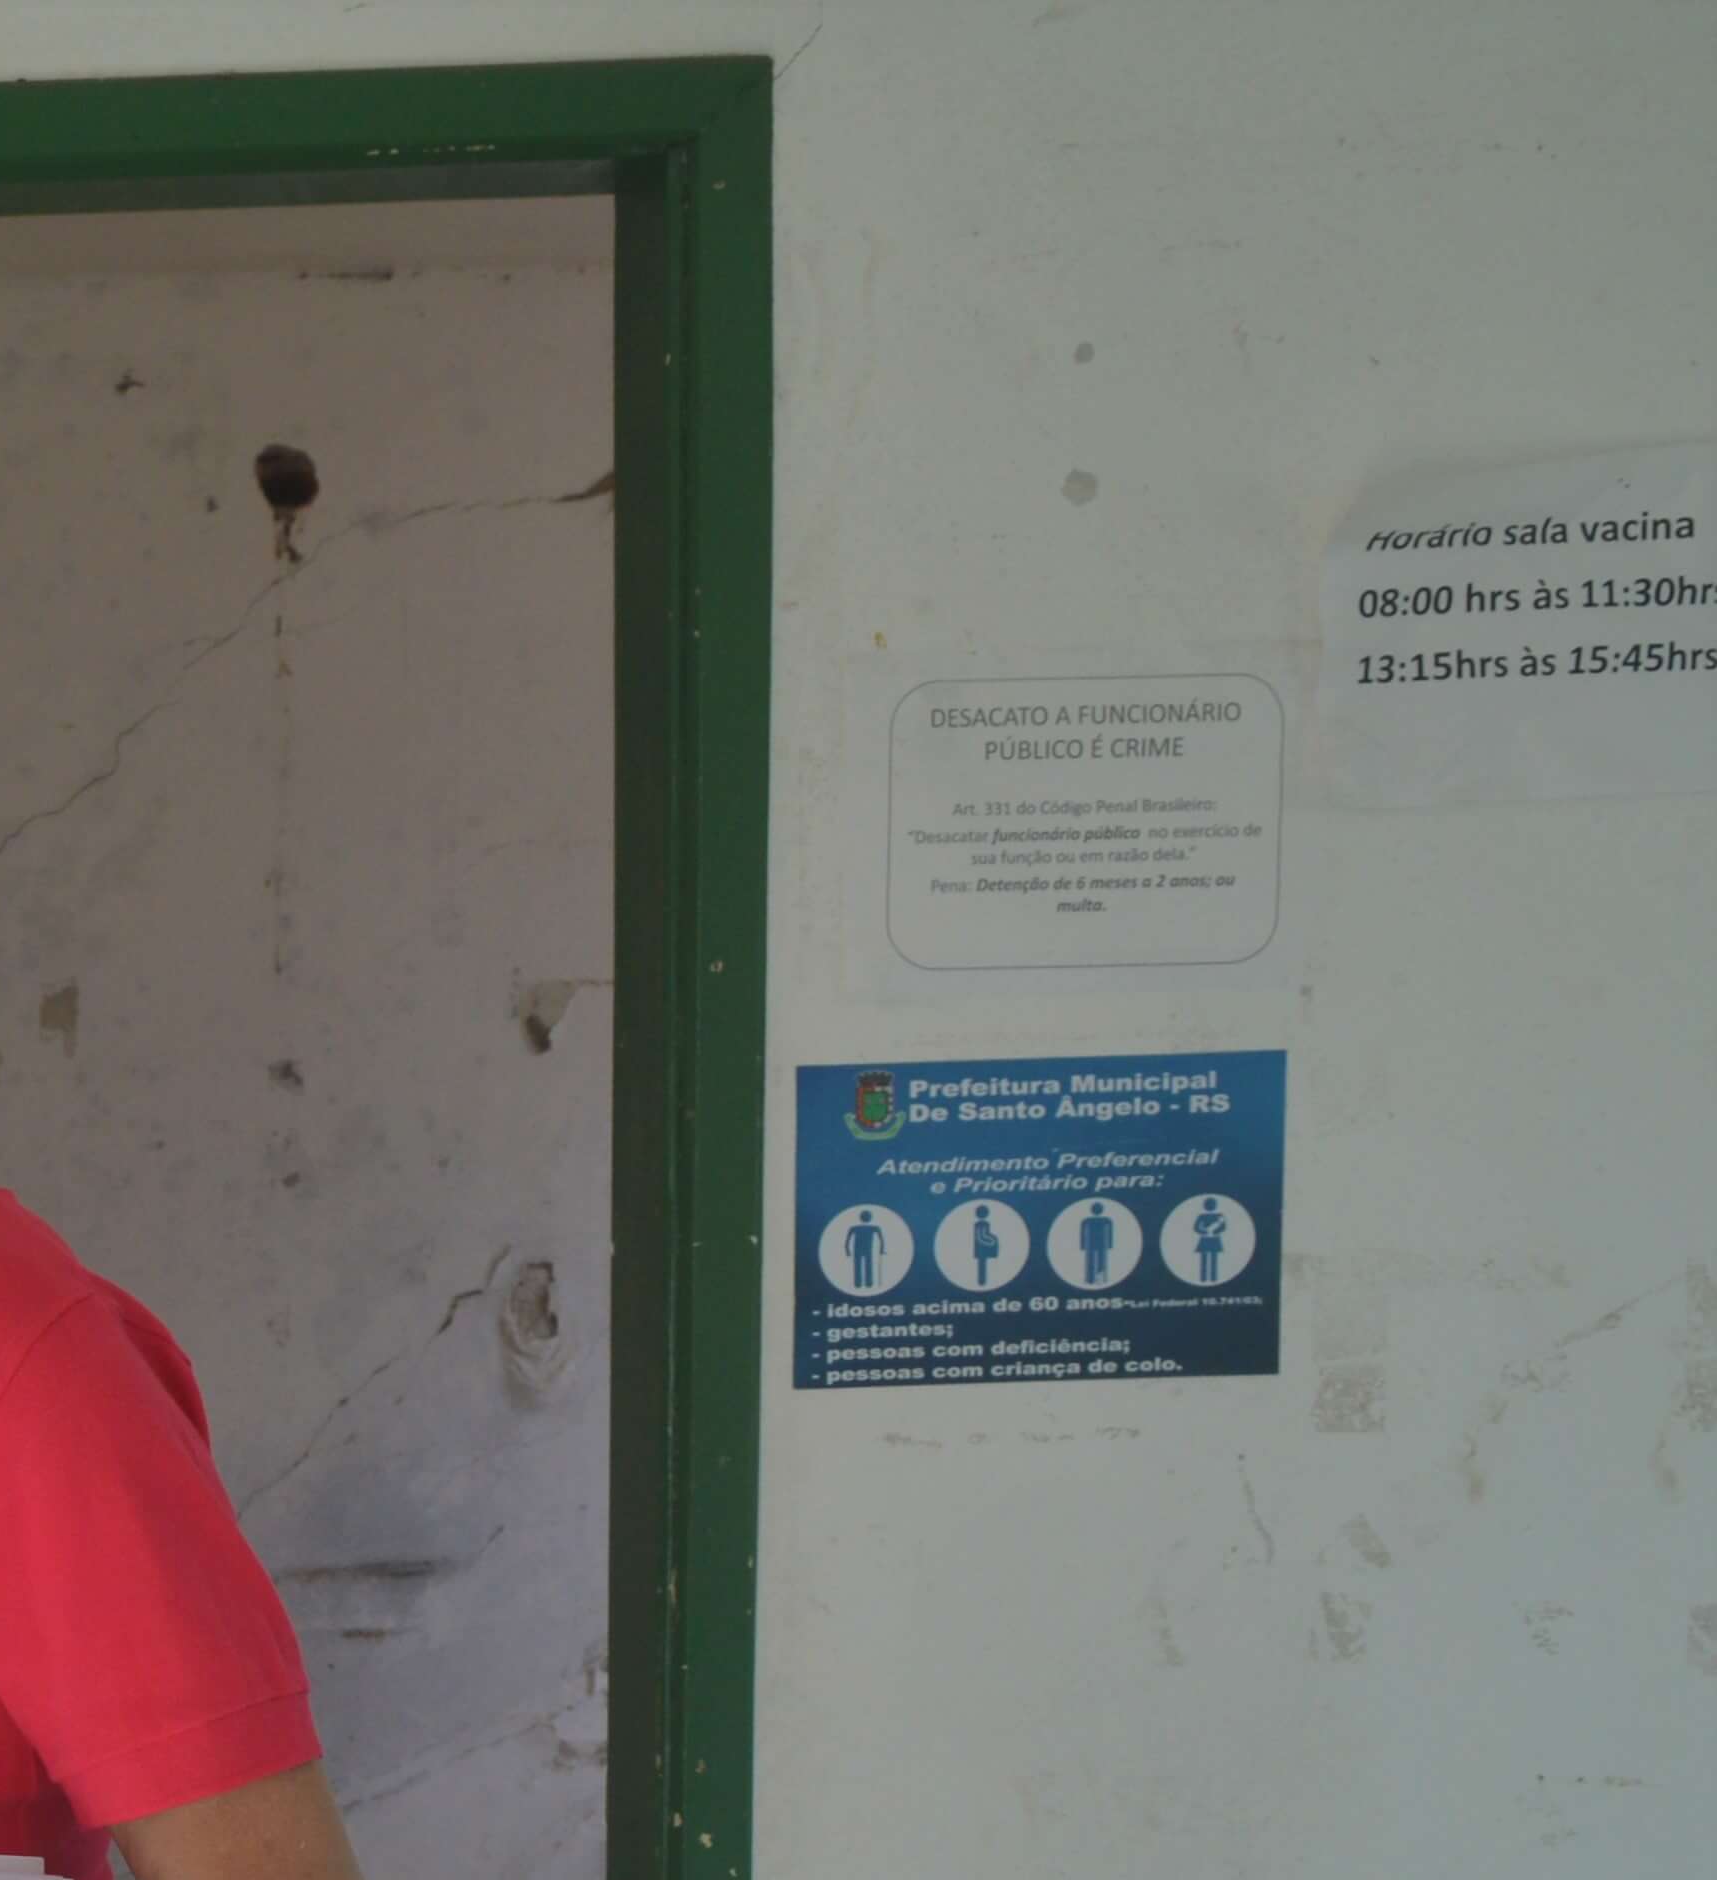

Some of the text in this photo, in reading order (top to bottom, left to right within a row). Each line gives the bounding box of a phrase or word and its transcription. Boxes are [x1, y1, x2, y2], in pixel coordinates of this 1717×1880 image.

[1366, 511, 1697, 551] Horário sala vacina
[1358, 585, 1454, 619] 08:00
[1466, 583, 1521, 613] hrs
[1533, 580, 1570, 610] às
[1357, 642, 1717, 684] 13:15hrs às 15:45hrs
[930, 698, 1242, 729] DESACATO A FUNCIONÁRIO
[984, 734, 1185, 761] PÚBLICO É CRIME
[908, 1070, 1219, 1099] Prefeitura Municipal
[908, 1104, 949, 1123] De
[958, 1098, 1051, 1122] Santo
[1055, 1094, 1161, 1122] Ângelo
[1189, 1093, 1231, 1114] RS
[876, 1147, 1221, 1175] Atendimento Preferencial
[929, 1173, 1165, 1195] e Prioritário para:
[827, 1298, 905, 1319] idosos
[912, 1297, 986, 1316] acima
[993, 1295, 1022, 1313] de
[1028, 1295, 1060, 1312] 60
[826, 1322, 955, 1343] gestantes;
[826, 1336, 1131, 1363] pessoas com deficiência;
[826, 1355, 1183, 1386] pessoas com criança de colo.
